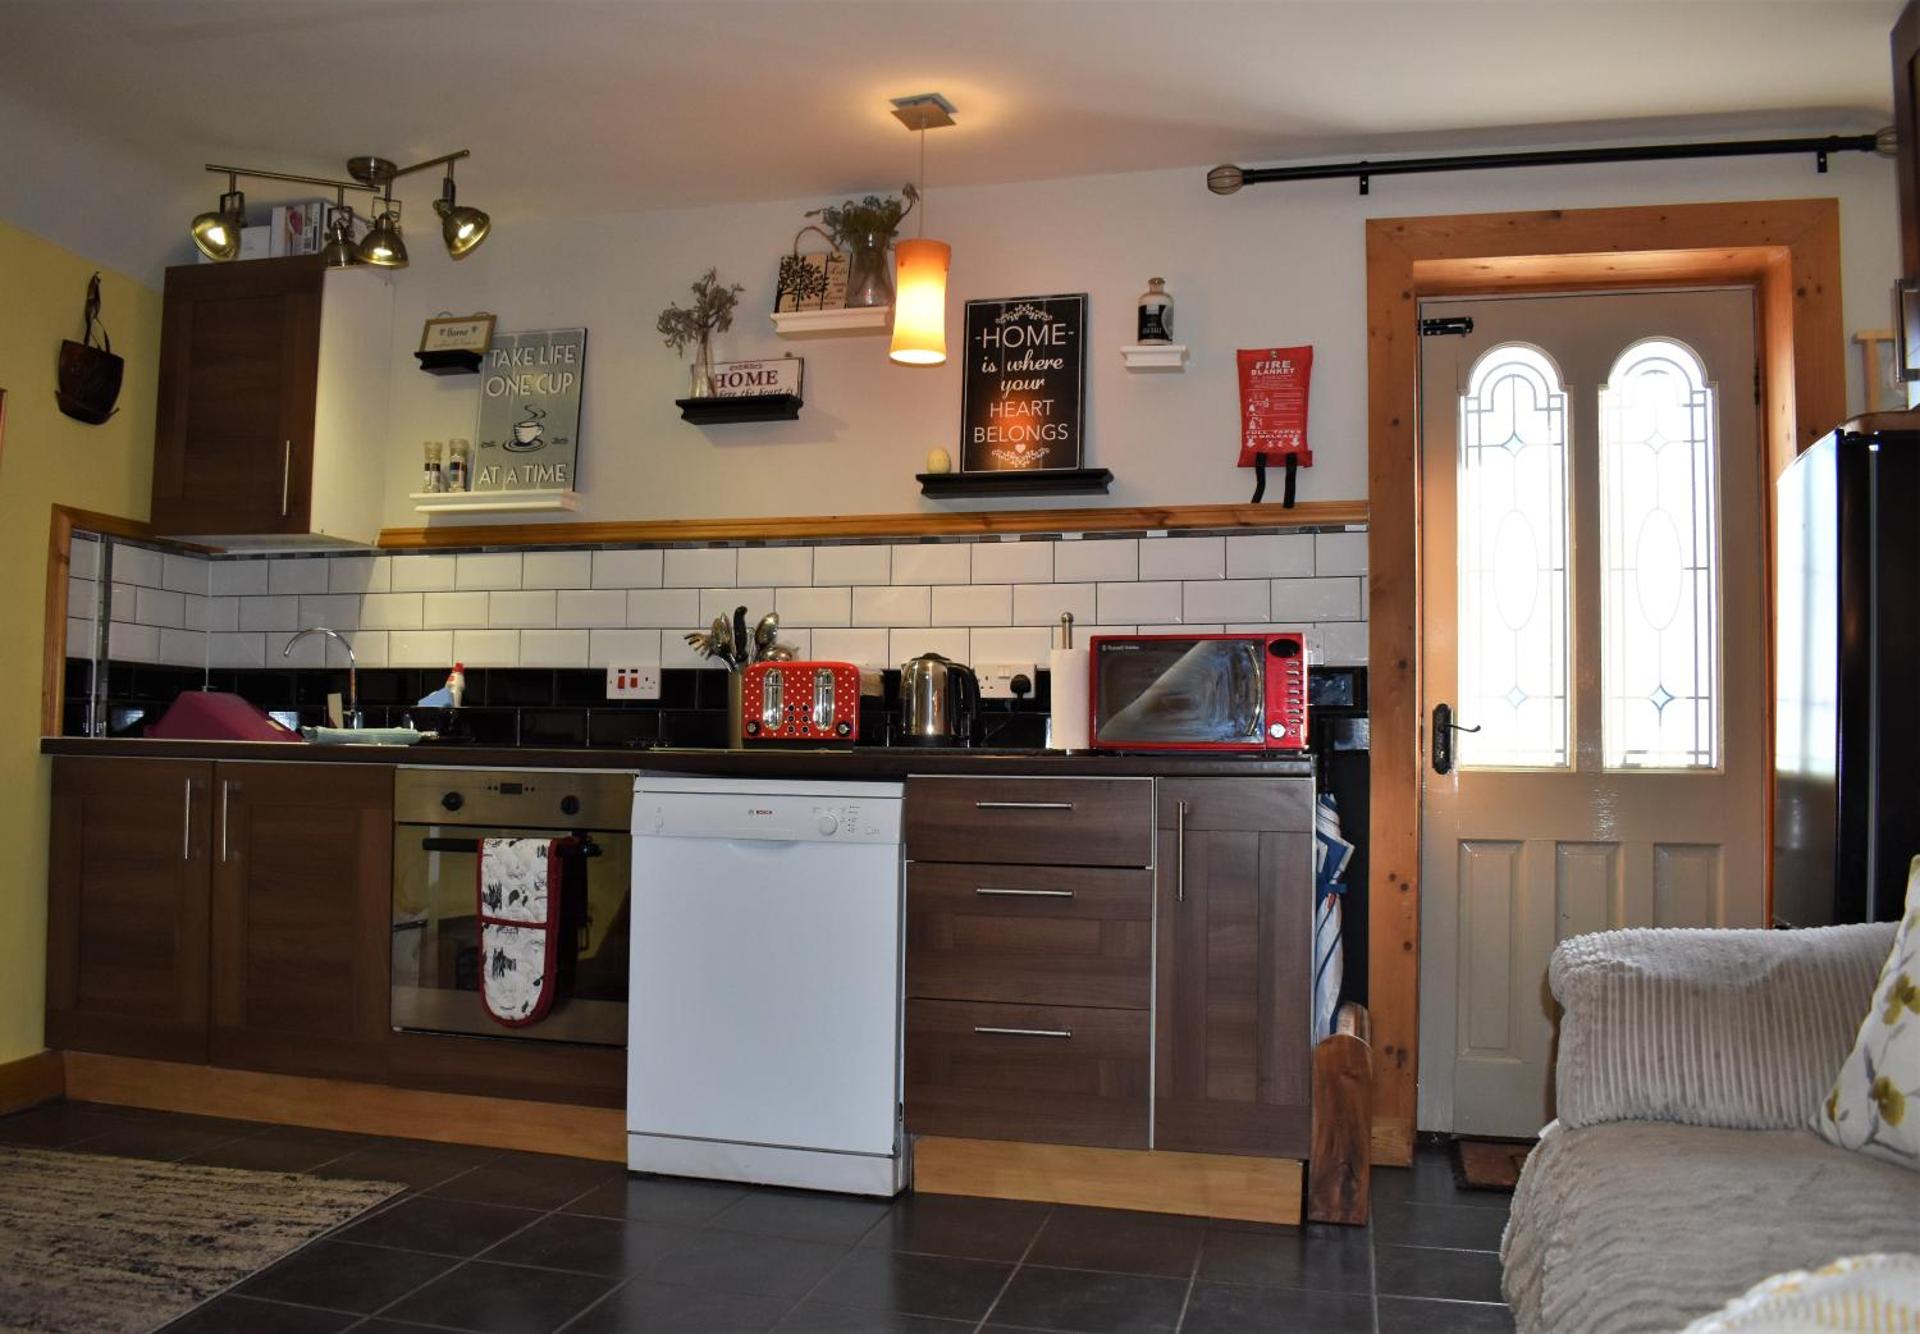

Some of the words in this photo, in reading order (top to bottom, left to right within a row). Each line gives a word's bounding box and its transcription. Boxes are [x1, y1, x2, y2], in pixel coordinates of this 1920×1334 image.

[491, 347, 535, 369] TAKE
[539, 345, 577, 365] LIFE
[981, 356, 998, 373] is
[1006, 349, 1065, 373] where
[1255, 360, 1291, 368] FIRE
[714, 370, 778, 389] HOME
[1250, 368, 1295, 376] BLANKET
[486, 374, 531, 397] ONE
[536, 372, 574, 395] CUP
[1000, 378, 1046, 399] your
[990, 399, 1055, 418] HEART
[974, 423, 1069, 443] BELONGS
[479, 465, 502, 485] AT
[505, 466, 519, 484] A
[523, 464, 567, 483] TIME
